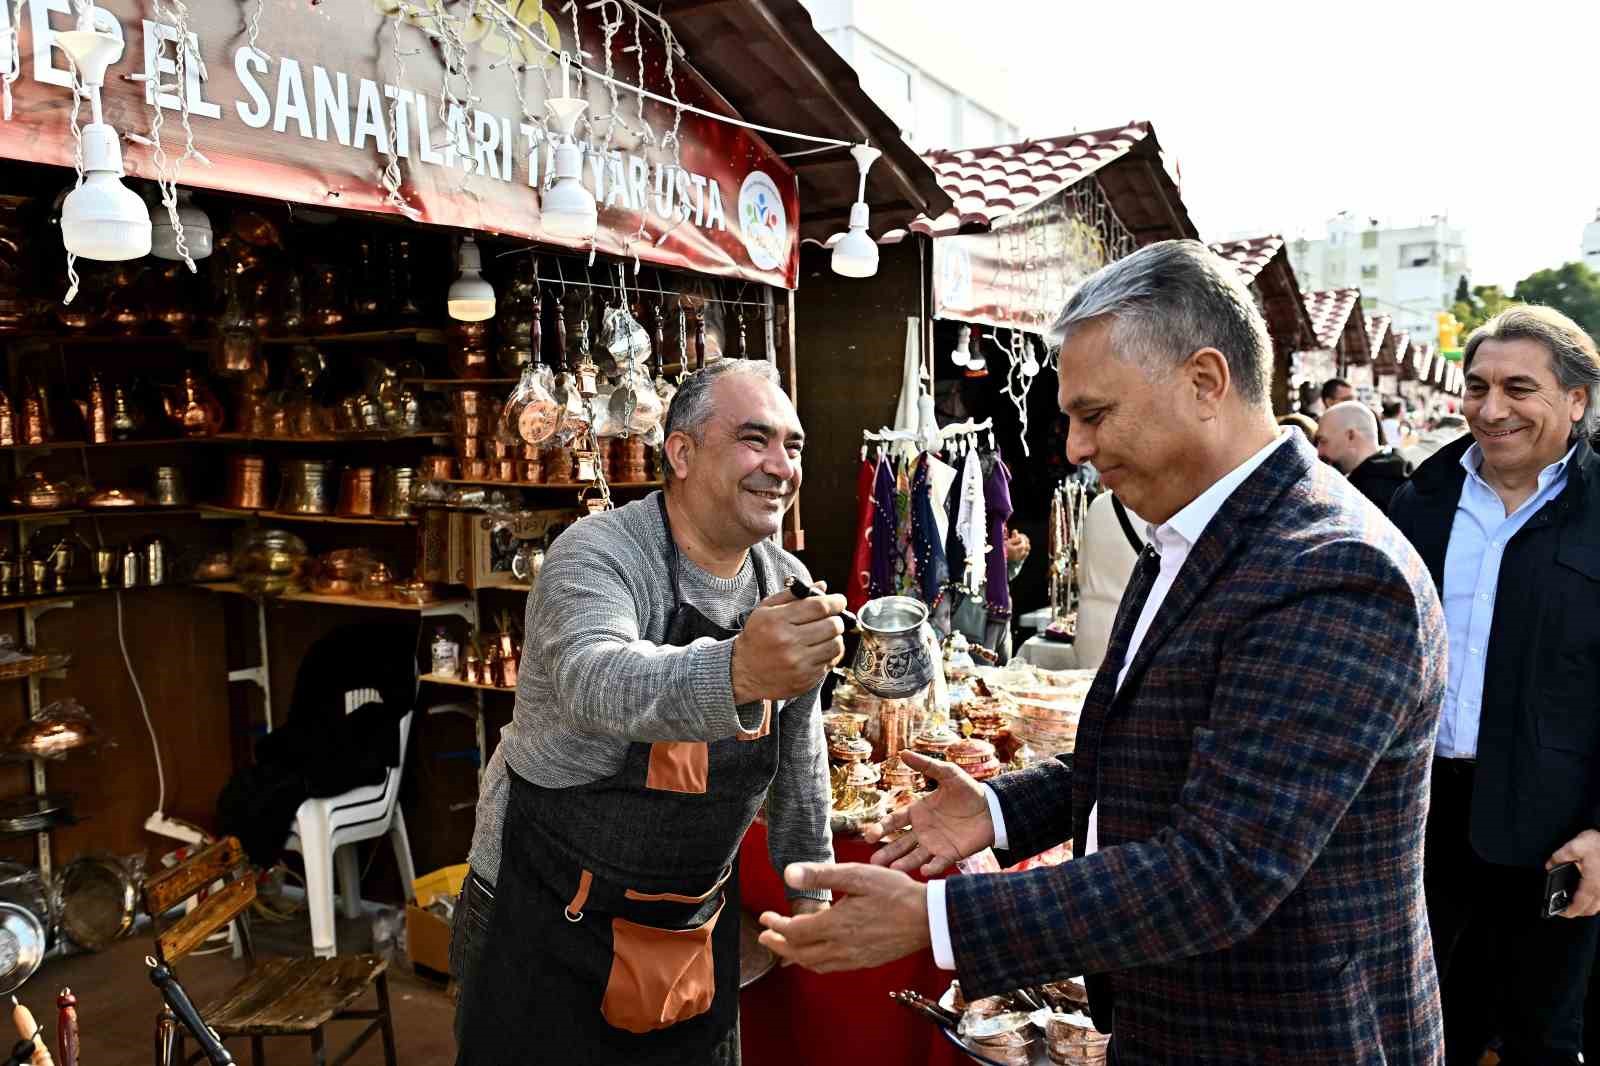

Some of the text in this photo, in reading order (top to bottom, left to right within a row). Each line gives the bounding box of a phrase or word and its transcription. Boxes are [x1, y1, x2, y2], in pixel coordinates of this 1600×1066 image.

[143, 19, 221, 119] EL
[235, 46, 512, 182] SANATLARI
[656, 163, 726, 231] USTA
